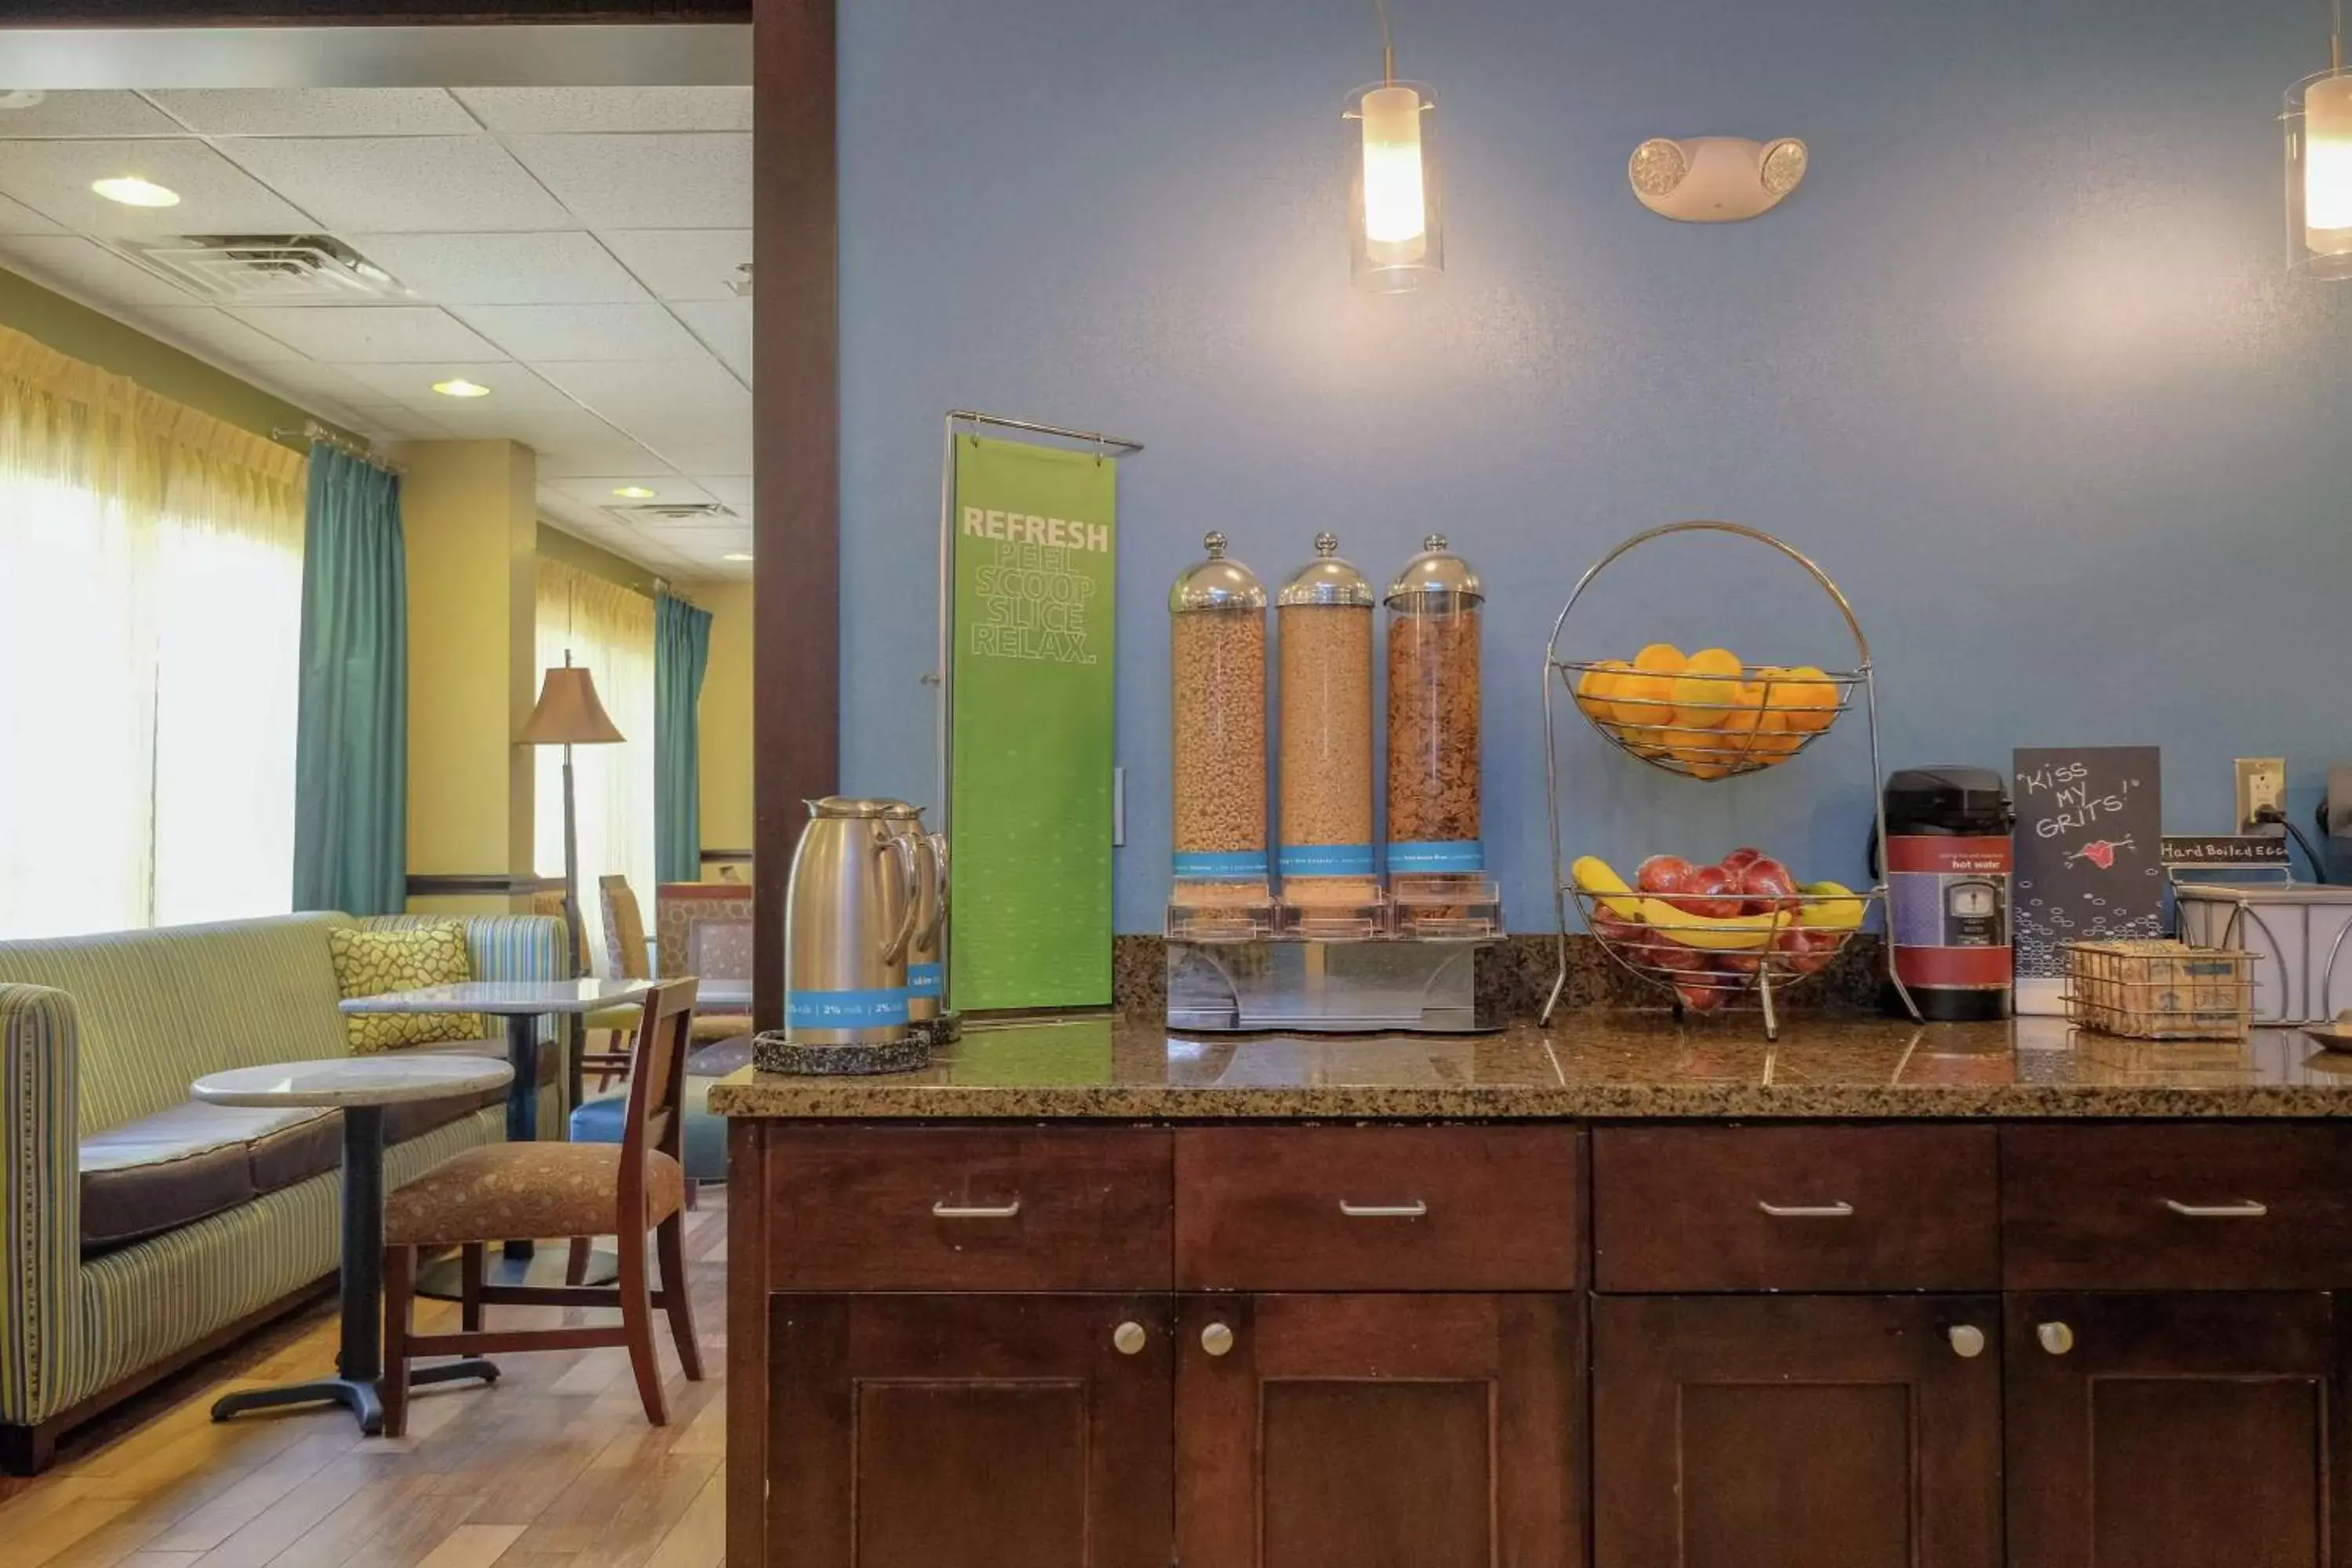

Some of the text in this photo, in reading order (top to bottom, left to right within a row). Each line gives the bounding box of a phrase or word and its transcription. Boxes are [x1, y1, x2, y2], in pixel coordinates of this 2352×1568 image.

[964, 506, 1108, 553] REFRESH
[996, 539, 1080, 573] PEEL
[976, 564, 1096, 607] SCOOP
[987, 596, 1085, 633] SLICE
[971, 622, 1098, 664] RELAX.
[2056, 781, 2086, 808] MY
[1952, 859, 1972, 870] hot
[2161, 842, 2204, 858] Hard
[2206, 844, 2253, 857] Boiled
